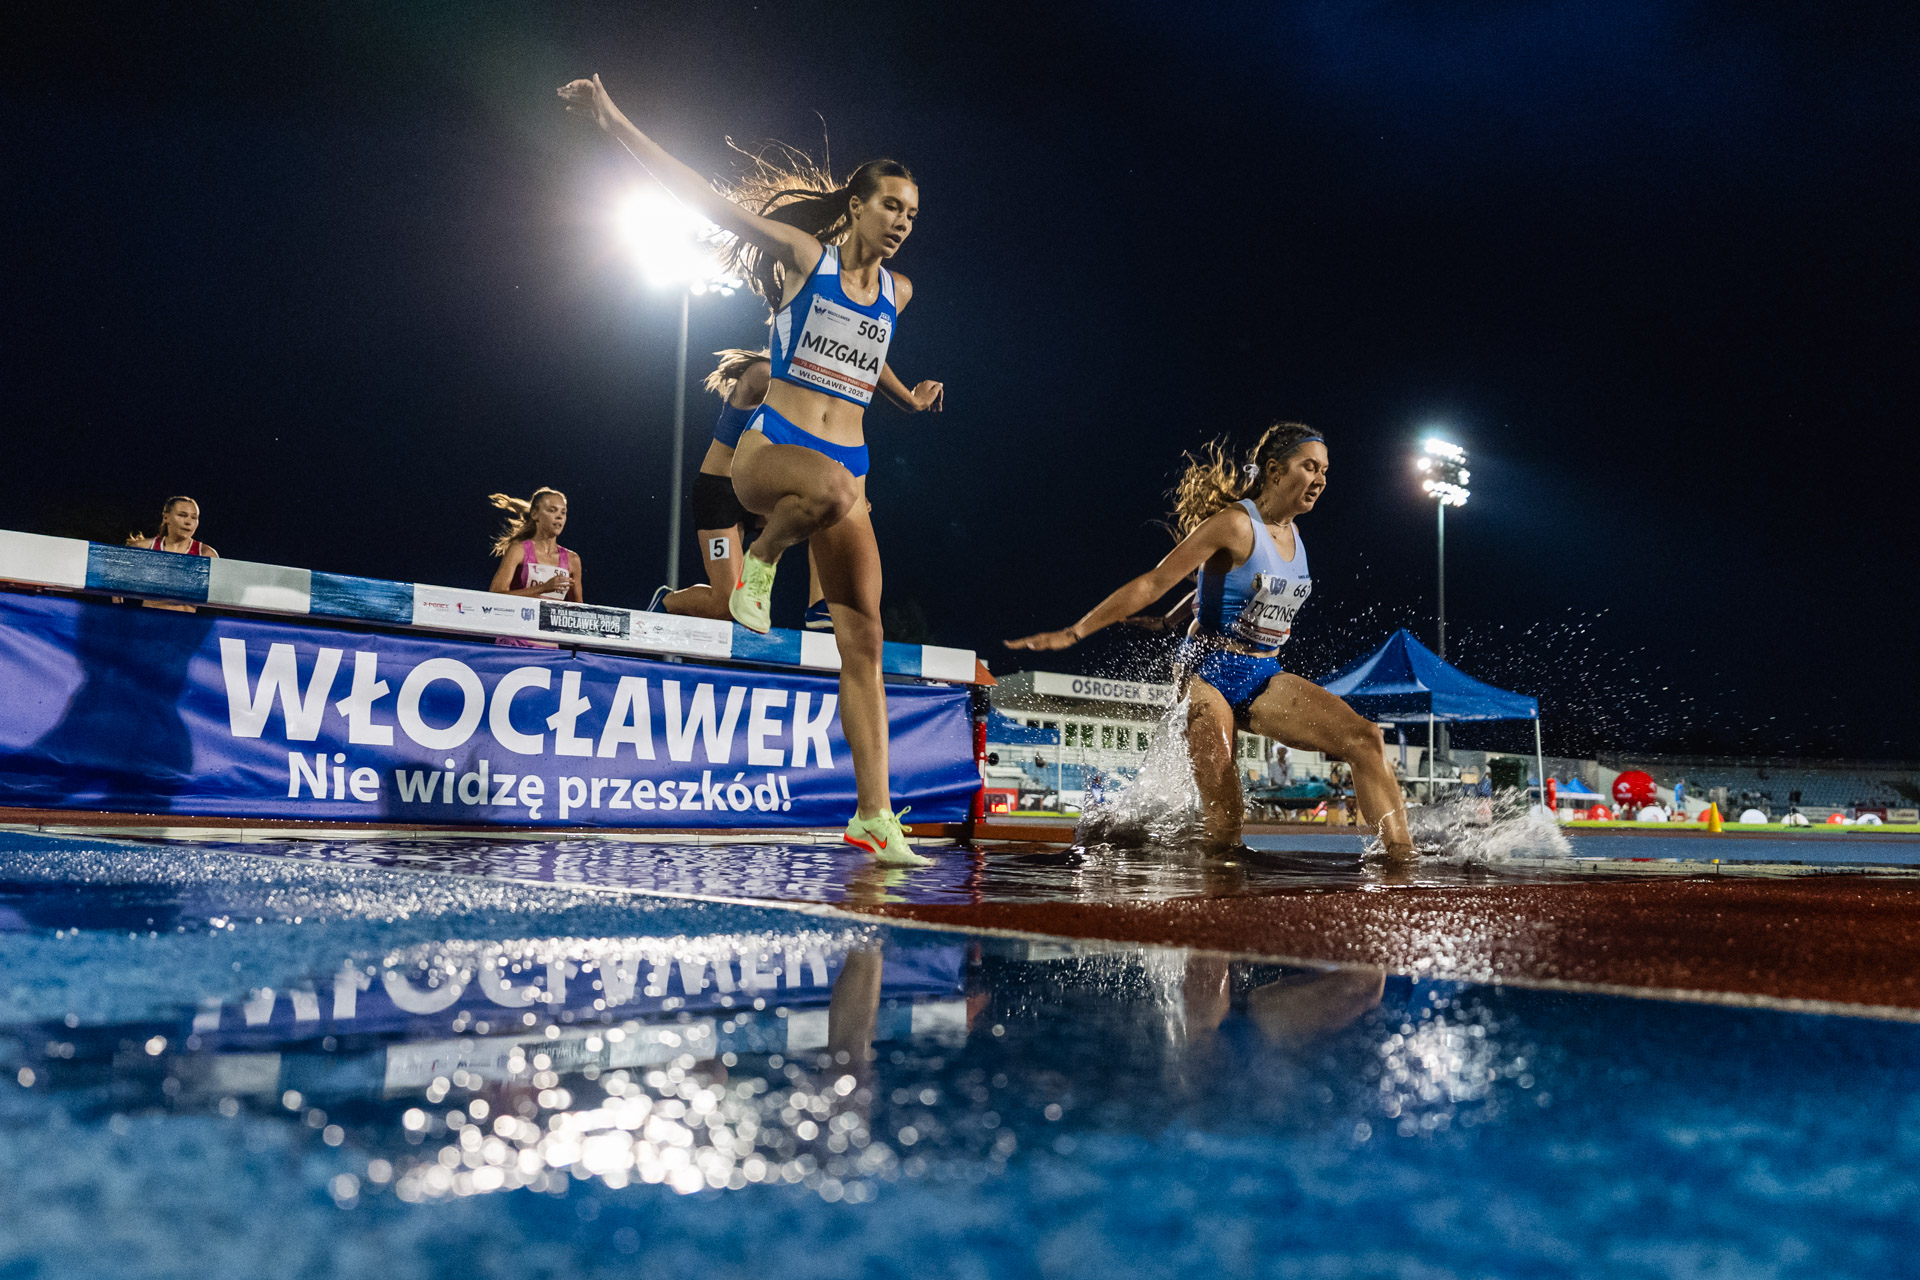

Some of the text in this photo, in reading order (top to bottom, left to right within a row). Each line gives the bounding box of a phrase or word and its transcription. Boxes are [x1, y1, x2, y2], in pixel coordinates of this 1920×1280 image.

[857, 320, 887, 343] 503
[801, 331, 879, 375] MIZGAŁA
[799, 369, 865, 398] WŁOCŁAWEK 2025
[713, 539, 725, 558] 5
[550, 614, 600, 632] WŁOCŁAWEK
[1072, 678, 1142, 699] OŚRODEK
[219, 637, 838, 769] WŁOCŁAWEK
[287, 751, 792, 820] Nie widzę przeszkód!
